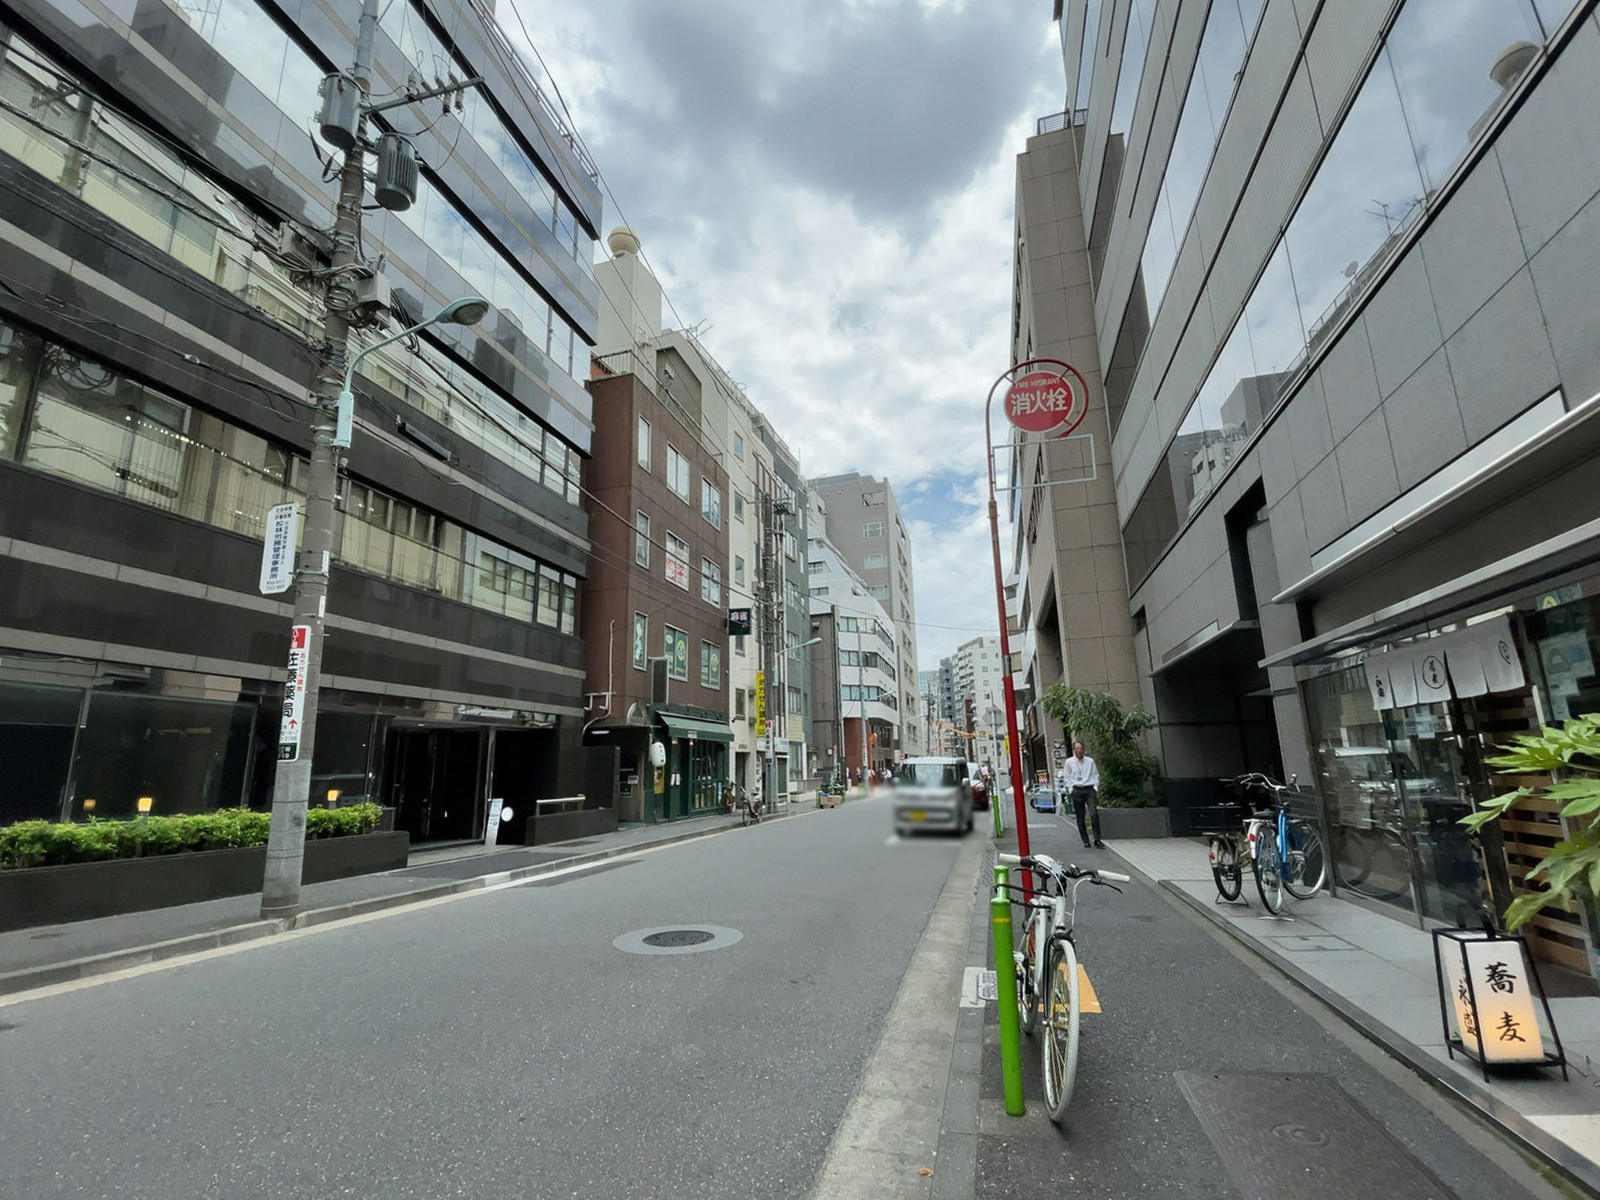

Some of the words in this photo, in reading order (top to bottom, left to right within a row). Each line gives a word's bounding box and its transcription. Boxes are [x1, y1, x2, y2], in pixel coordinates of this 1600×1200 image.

[1015, 381, 1029, 389] FIRE
[1030, 377, 1060, 387] HYDRANT
[1010, 387, 1068, 416] 消火栓
[1484, 961, 1526, 1042] 蕎麦
